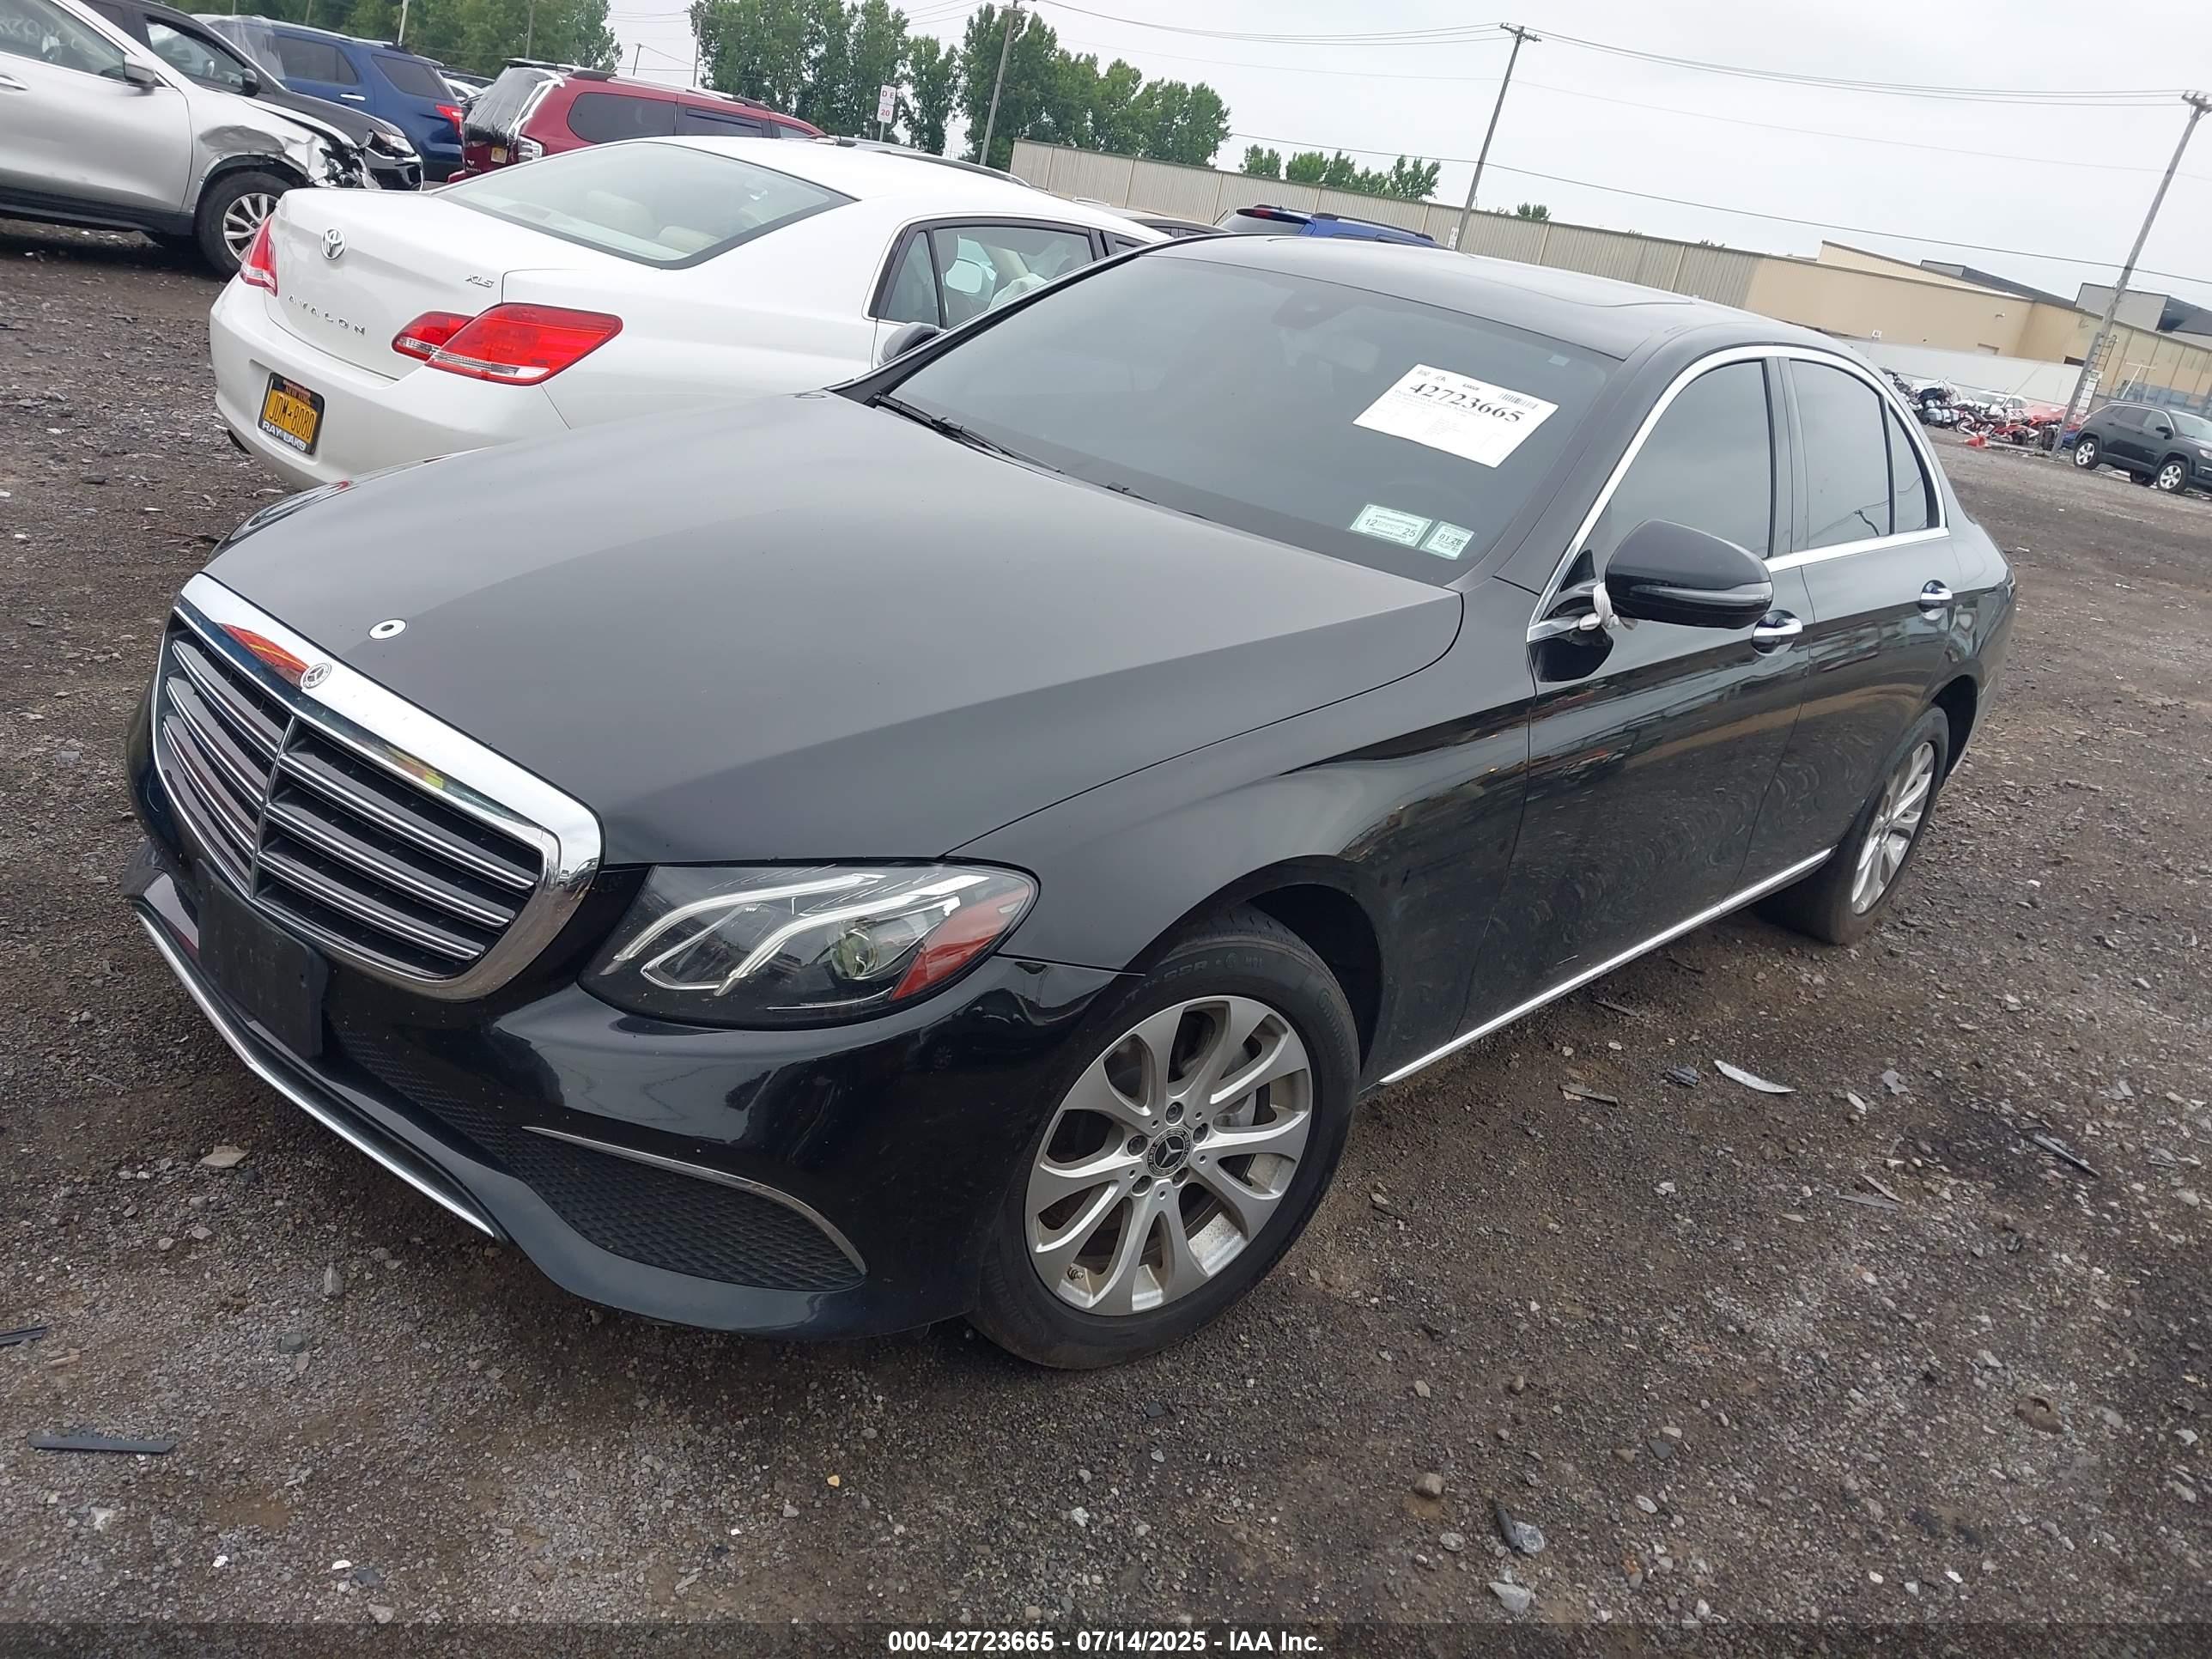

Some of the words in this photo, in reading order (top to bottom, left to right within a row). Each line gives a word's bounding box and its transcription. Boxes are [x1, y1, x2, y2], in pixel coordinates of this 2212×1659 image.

[465, 274, 495, 289] XLS
[289, 295, 367, 336] AVALON
[1410, 383, 1526, 422] 42723665
[262, 421, 282, 437] RAY
[283, 432, 307, 452] LAKS
[1365, 519, 1378, 527] 12
[1402, 527, 1416, 538] 25
